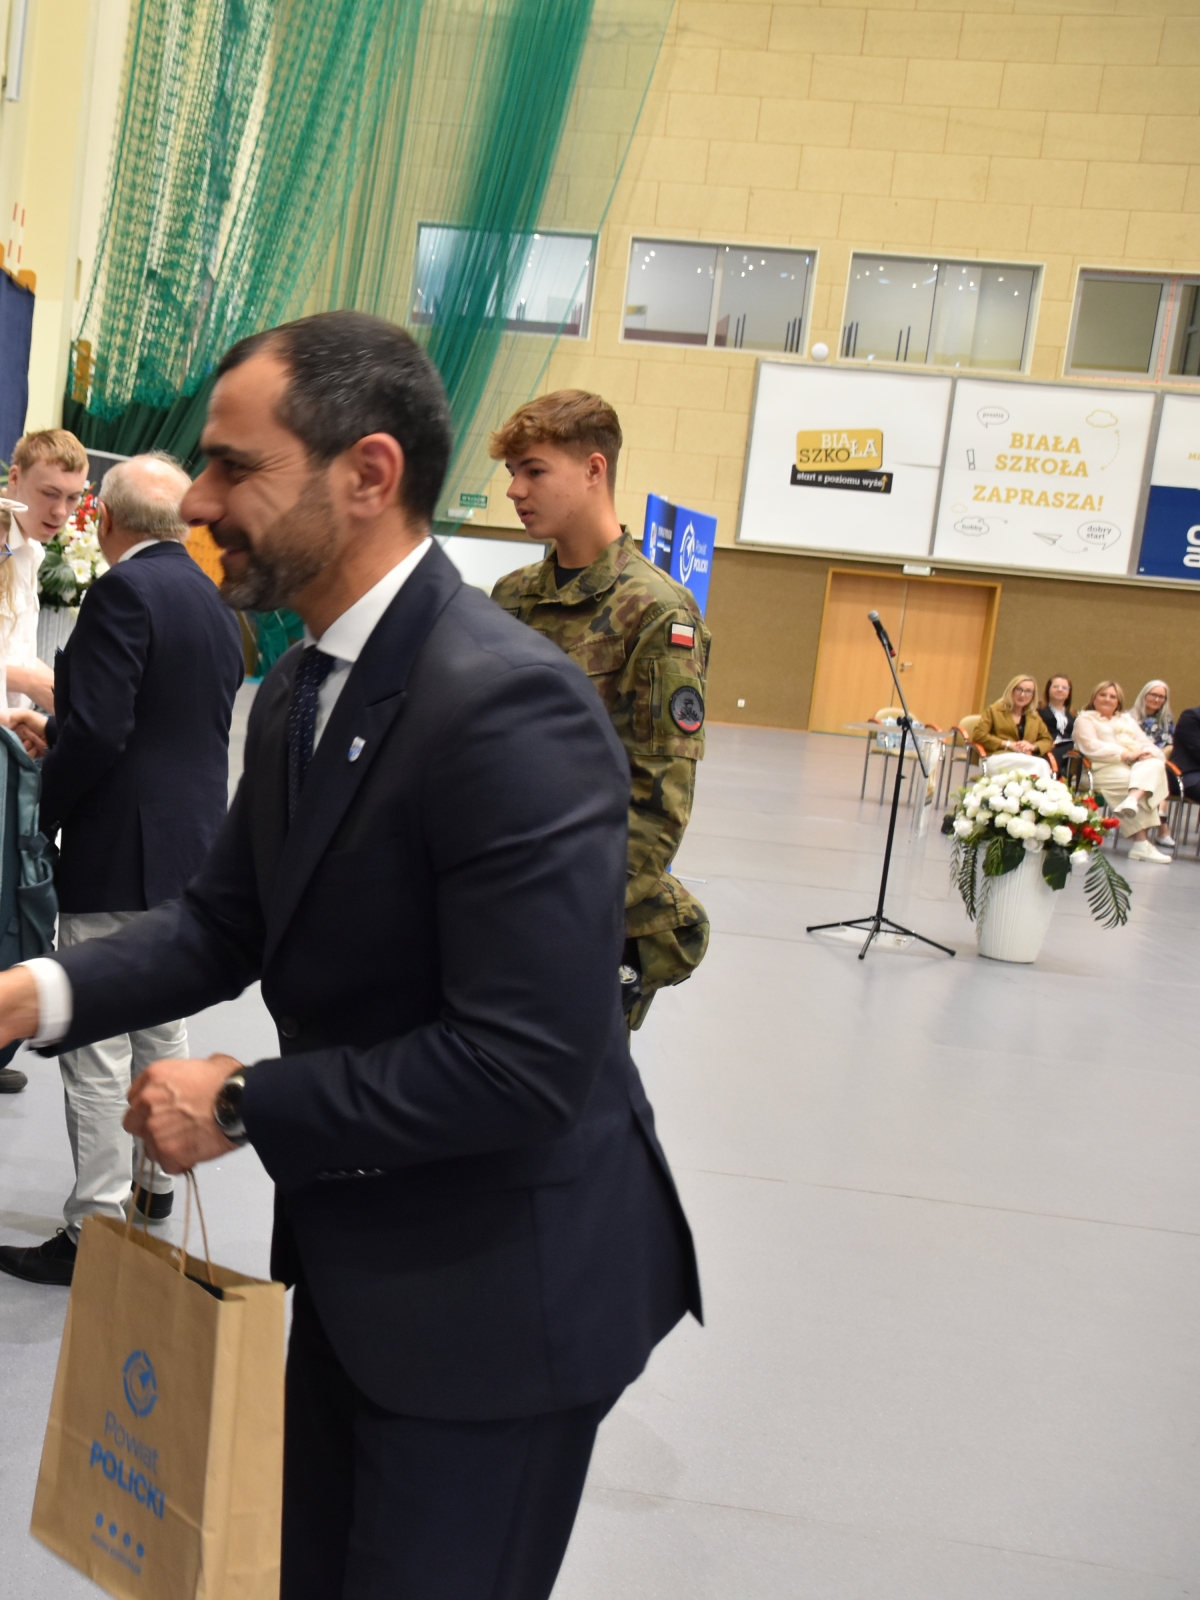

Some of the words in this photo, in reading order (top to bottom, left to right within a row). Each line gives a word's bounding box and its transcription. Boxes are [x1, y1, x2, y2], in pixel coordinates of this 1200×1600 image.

[1009, 432, 1081, 454] BIAŁA
[995, 454, 1089, 478] SZKOŁA
[972, 484, 1104, 512] ZAPRASZA!
[90, 1440, 164, 1519] POLICKI
